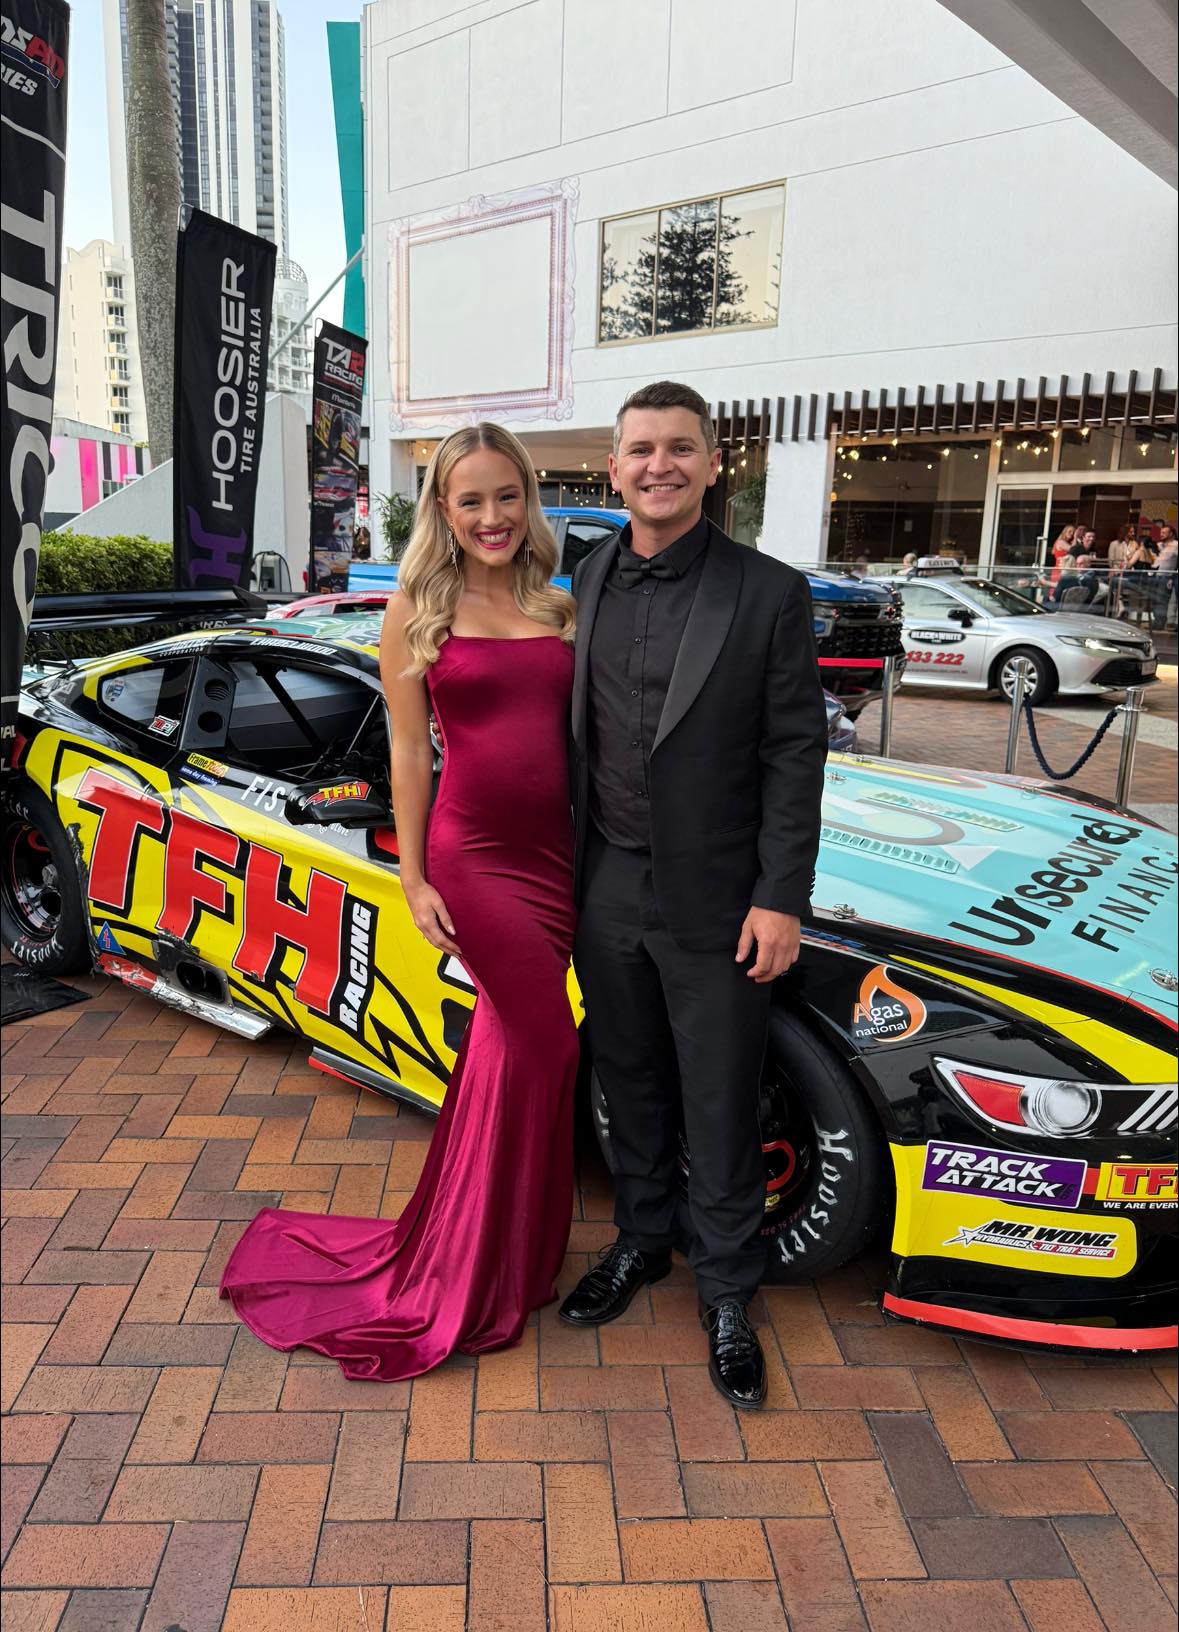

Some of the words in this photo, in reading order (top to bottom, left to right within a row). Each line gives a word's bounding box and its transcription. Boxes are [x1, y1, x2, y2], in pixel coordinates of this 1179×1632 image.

[245, 308, 261, 422] AUSTRALIA
[212, 257, 246, 512] HOOSIER
[240, 427, 256, 473] TIRE
[933, 652, 965, 666] 222
[75, 766, 349, 1016] TFH
[1071, 846, 1178, 953] FINANC
[339, 902, 372, 1032] RACING
[853, 1002, 905, 1026] Agas
[855, 1019, 908, 1038] national
[931, 1147, 1051, 1181] TRACK
[936, 1168, 1064, 1199] ATTACK
[1115, 1166, 1178, 1196] TF
[1103, 1201, 1121, 1209] WE
[1124, 1201, 1147, 1209] ARE
[974, 1234, 1028, 1249] HYDRAULICS
[1056, 1244, 1077, 1255] TRAY
[1077, 1246, 1111, 1258] SERVICE
[986, 1219, 1033, 1239] MR
[1032, 1225, 1117, 1248] WONG
